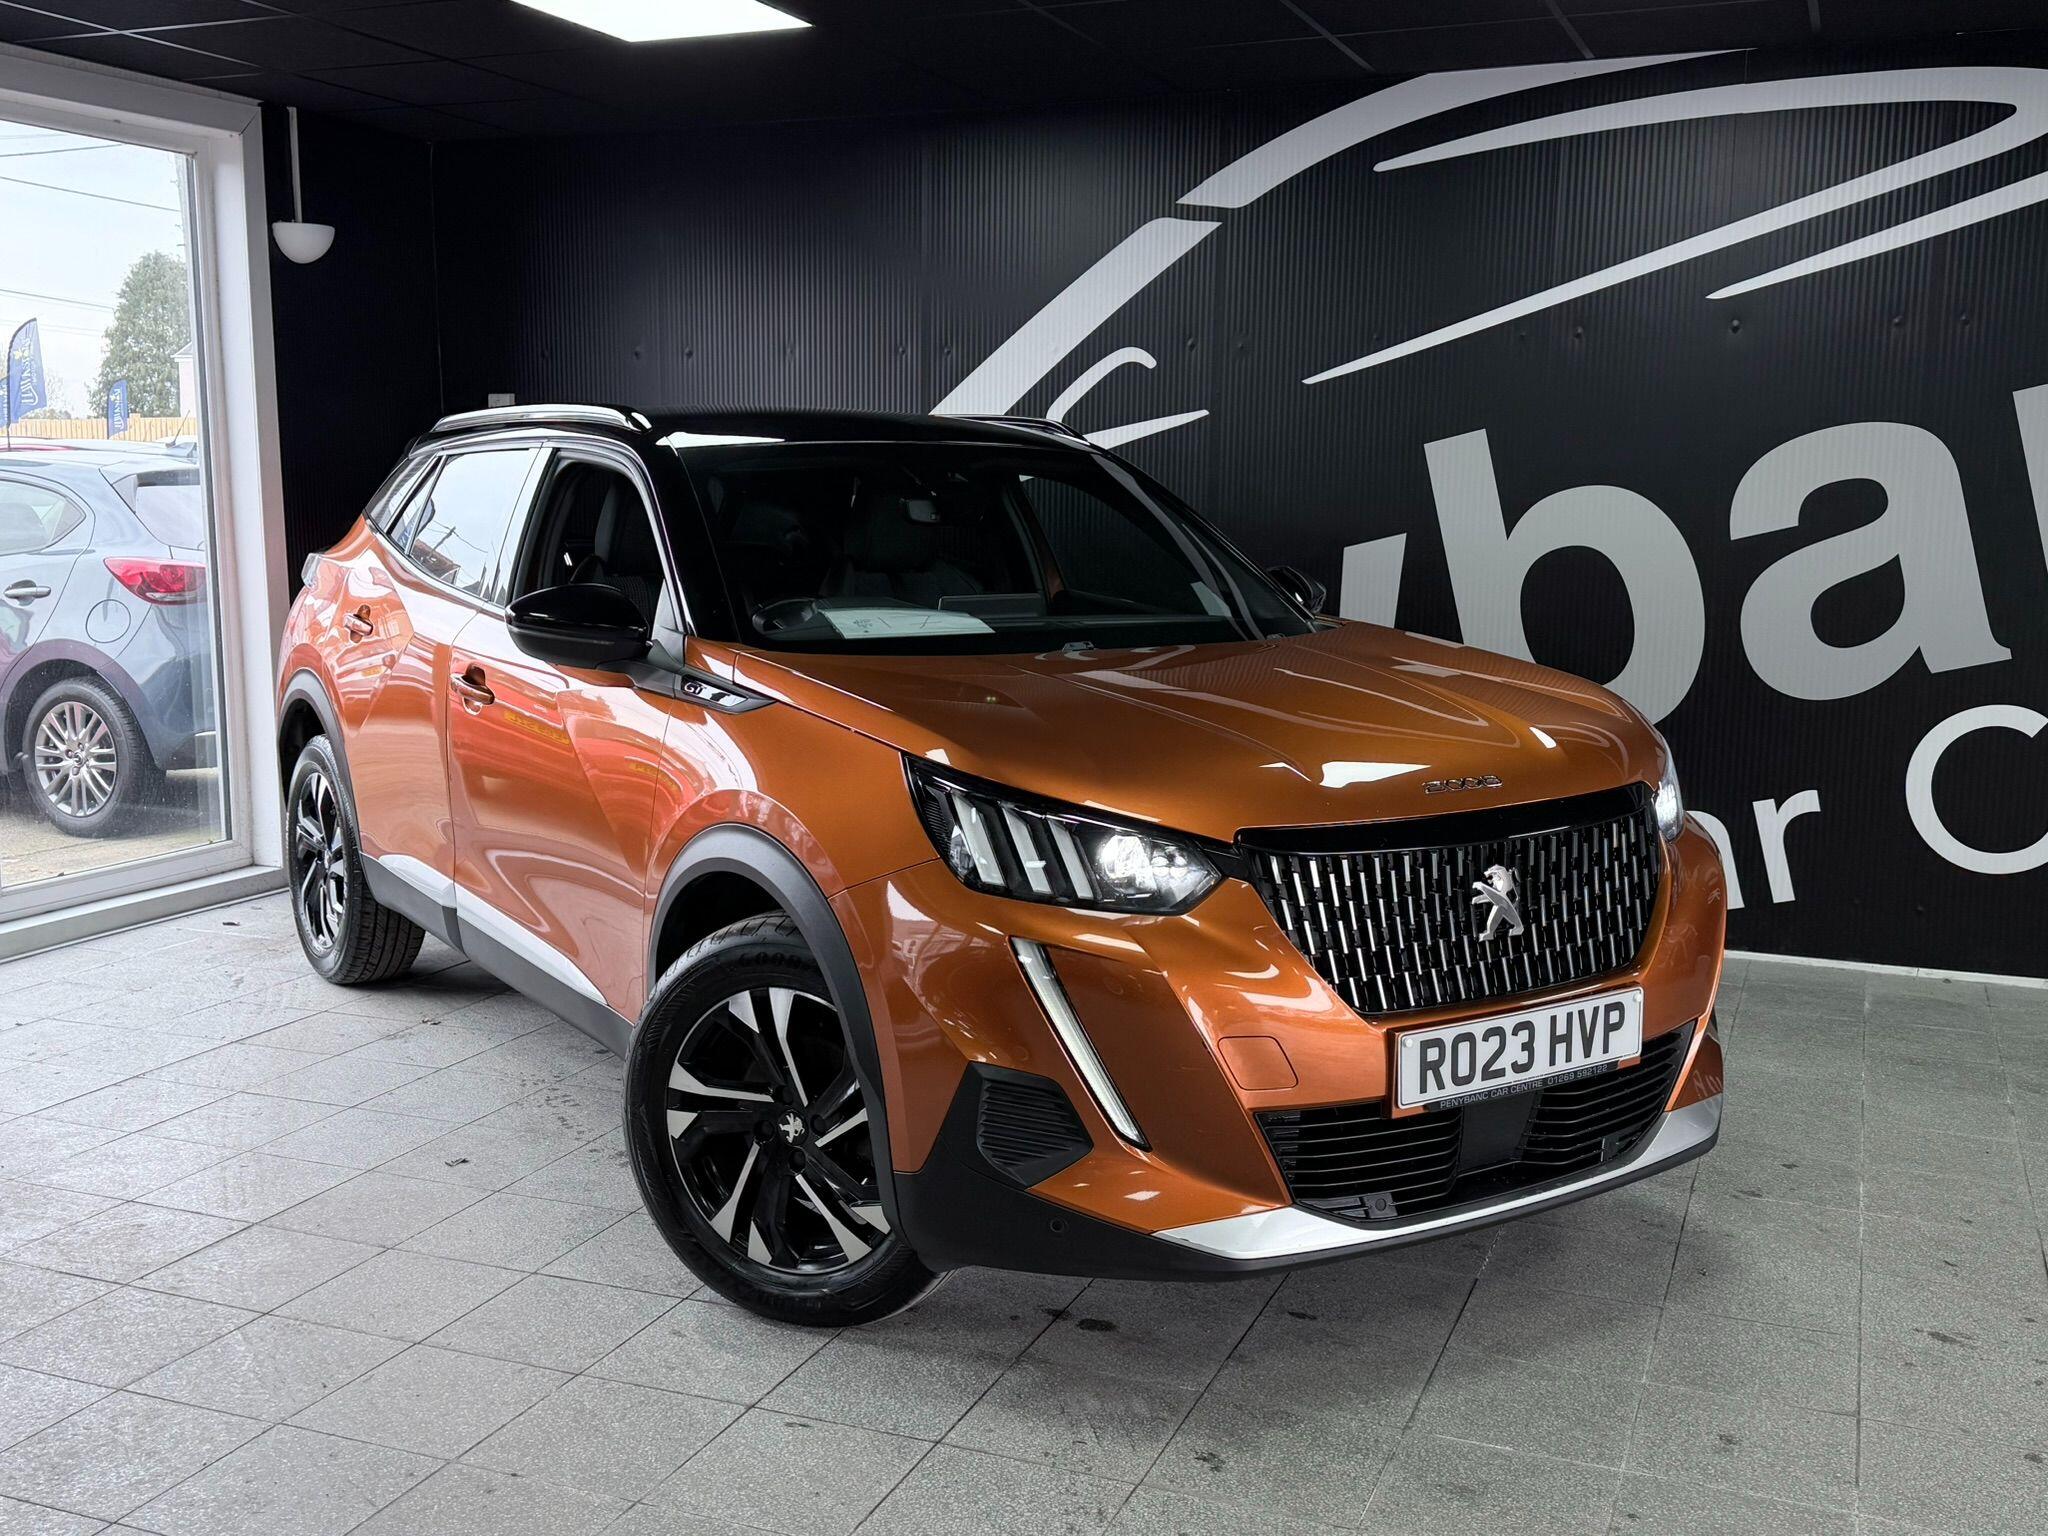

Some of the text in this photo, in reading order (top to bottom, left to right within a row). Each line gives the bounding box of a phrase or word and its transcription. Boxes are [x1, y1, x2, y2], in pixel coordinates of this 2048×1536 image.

[684, 681, 707, 694] GT
[1421, 775, 1503, 794] 2008
[1419, 1001, 1626, 1095] RO23 HVP
[1440, 1091, 1489, 1109] PENYBANC
[1490, 1087, 1509, 1098] CAR
[1510, 1079, 1543, 1094] CENTRE
[1547, 1072, 1575, 1085] 01269
[1576, 1064, 1609, 1079] 592122
